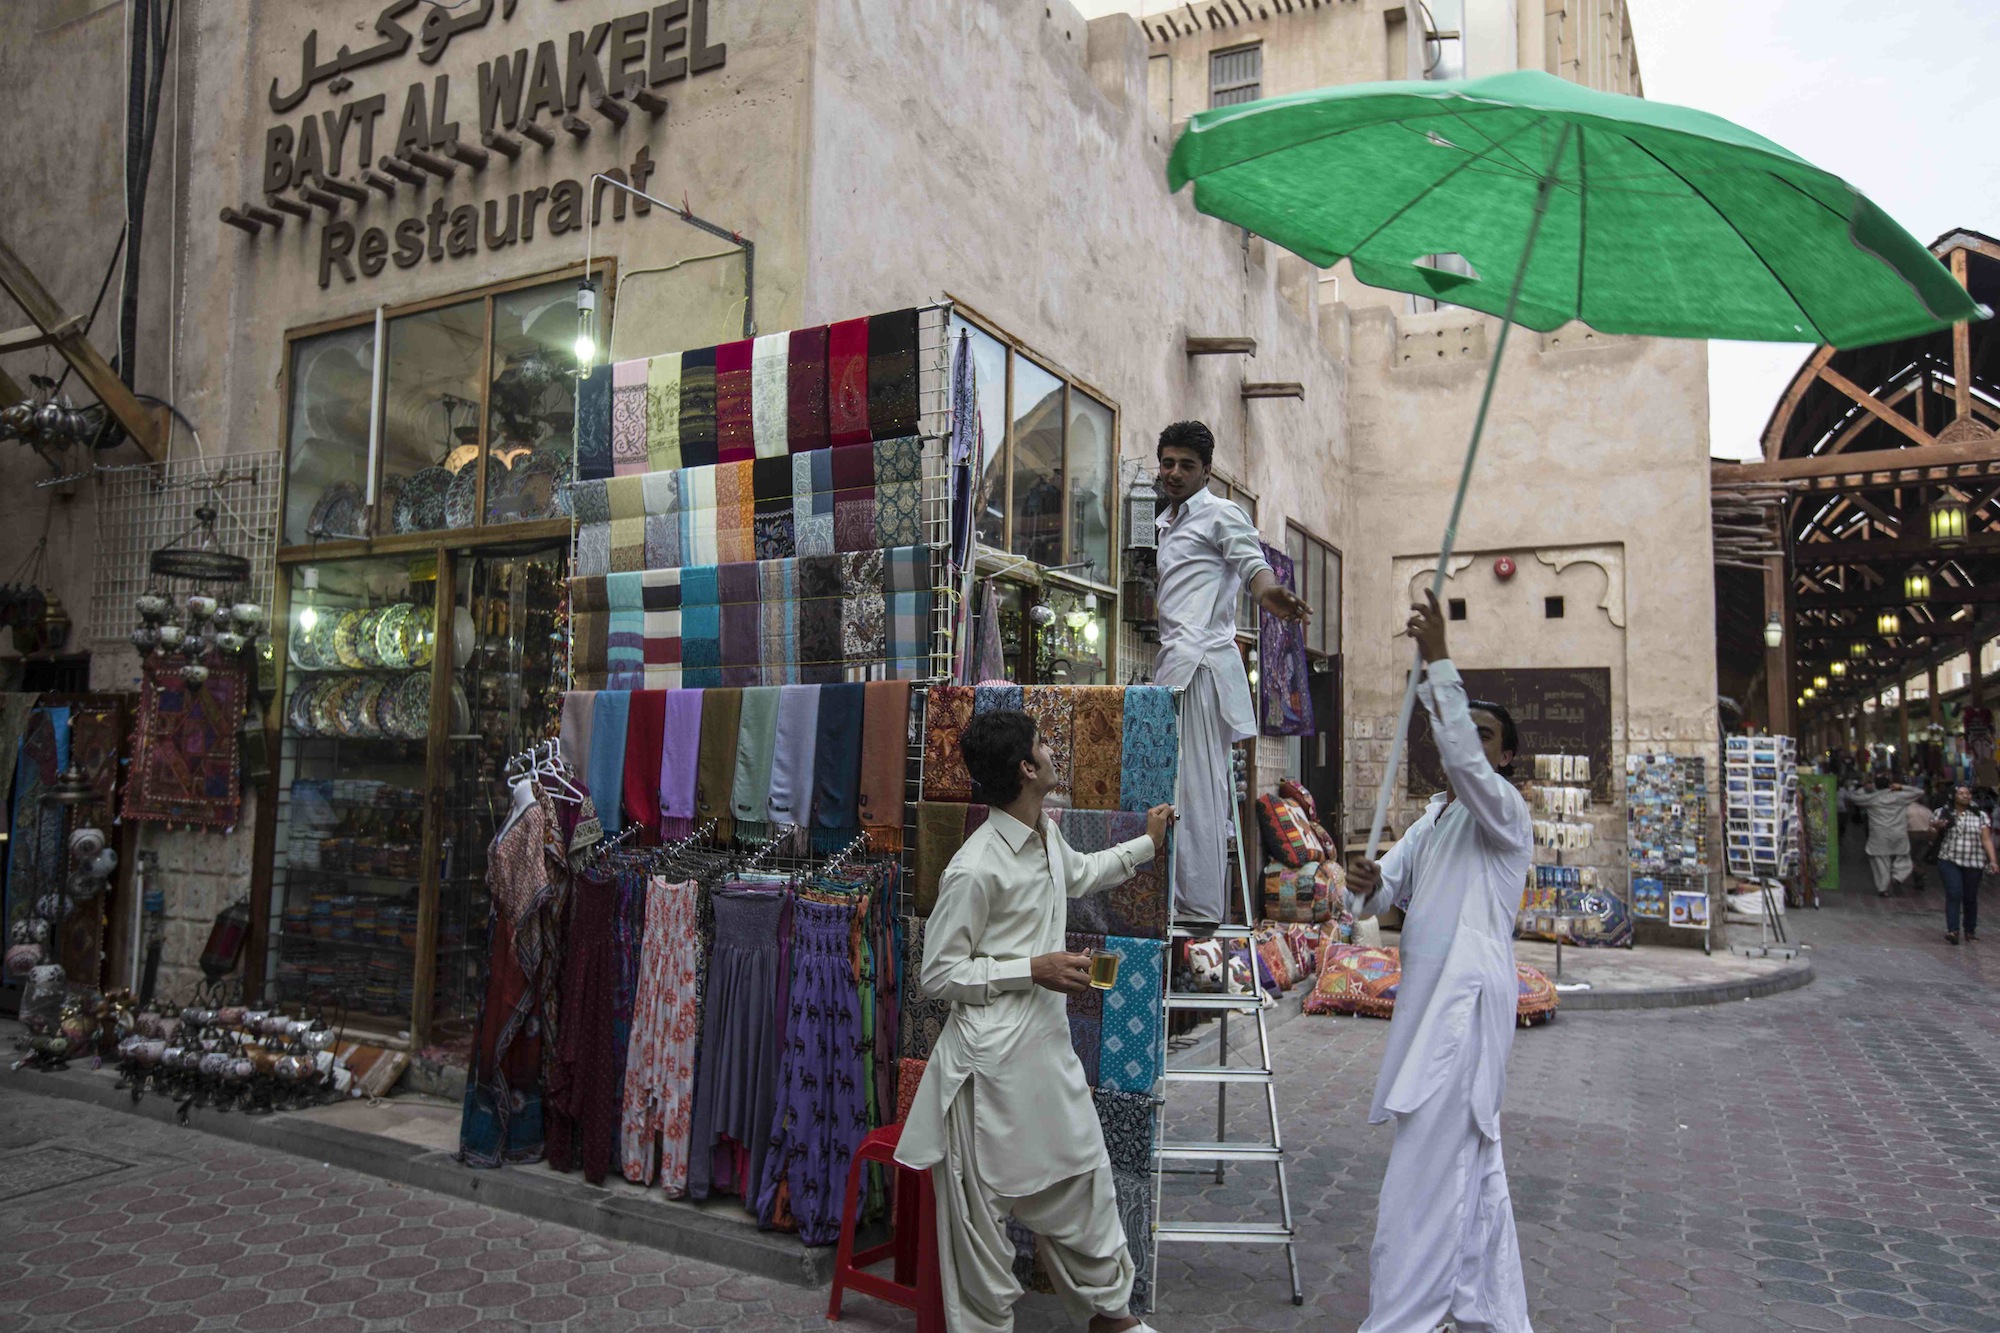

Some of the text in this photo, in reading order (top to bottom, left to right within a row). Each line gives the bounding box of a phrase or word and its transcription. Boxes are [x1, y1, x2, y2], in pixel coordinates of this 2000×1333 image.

[264, 0, 726, 193] BAYT AL WAKEEL
[318, 145, 655, 288] Restaurant
